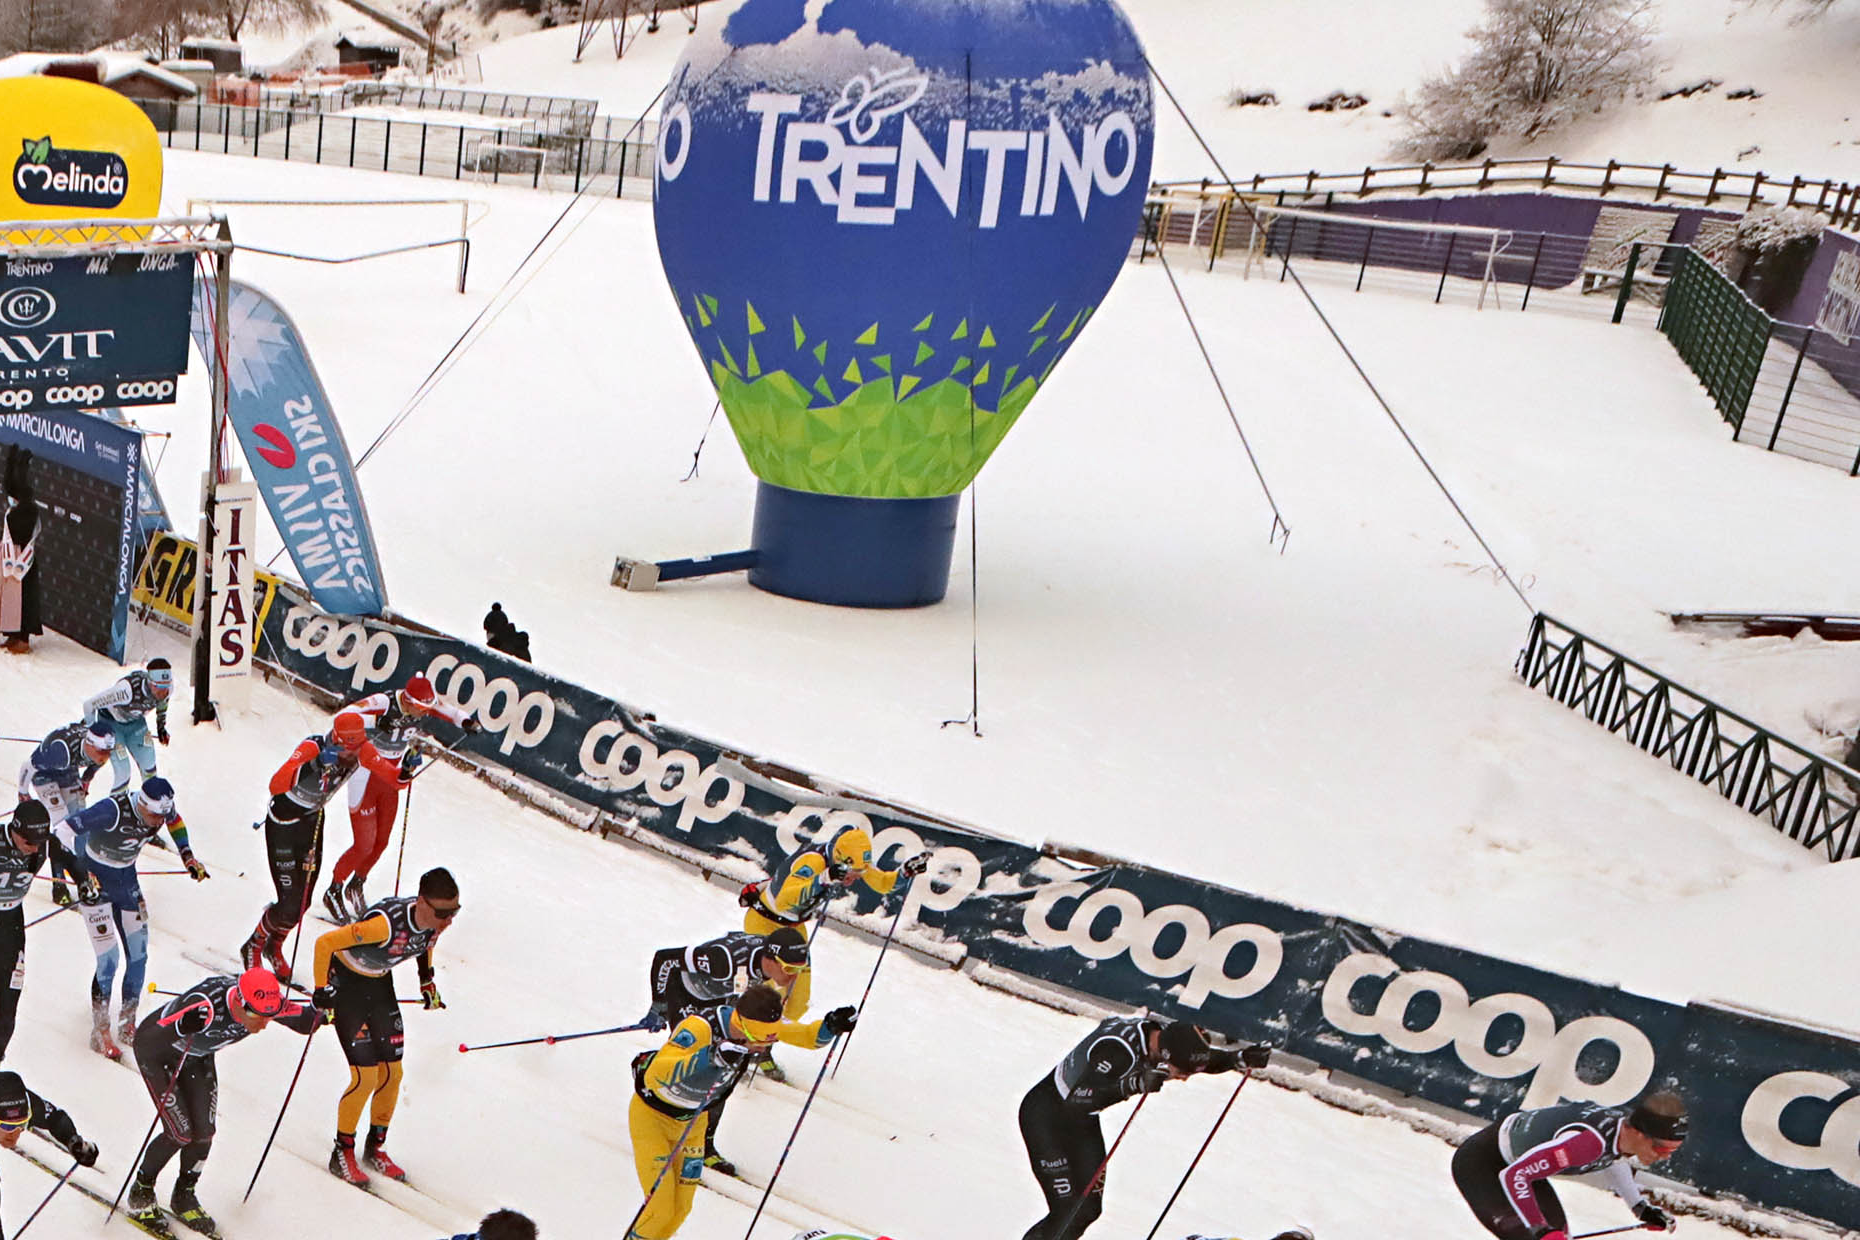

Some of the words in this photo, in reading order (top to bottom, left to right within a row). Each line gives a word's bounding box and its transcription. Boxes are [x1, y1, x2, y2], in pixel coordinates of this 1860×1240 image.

[17, 162, 124, 195] Melinda
[746, 92, 1138, 229] TRENTINO
[6, 261, 53, 278] TRENTINO
[86, 254, 179, 275] MAONGA
[45, 384, 104, 405] coop
[116, 379, 174, 400] coop
[6, 413, 85, 453] MARCIALONGA
[118, 463, 137, 596] MARCIALONGA
[216, 508, 247, 667] ITAS
[282, 604, 399, 691] coop
[390, 727, 417, 742] 18
[424, 653, 555, 756] coop
[578, 719, 746, 832] coop
[775, 804, 983, 925] coop
[697, 954, 711, 975] 157
[1022, 881, 1283, 1008] coop
[656, 958, 681, 995] MOELVEN
[1322, 952, 1656, 1113] coop
